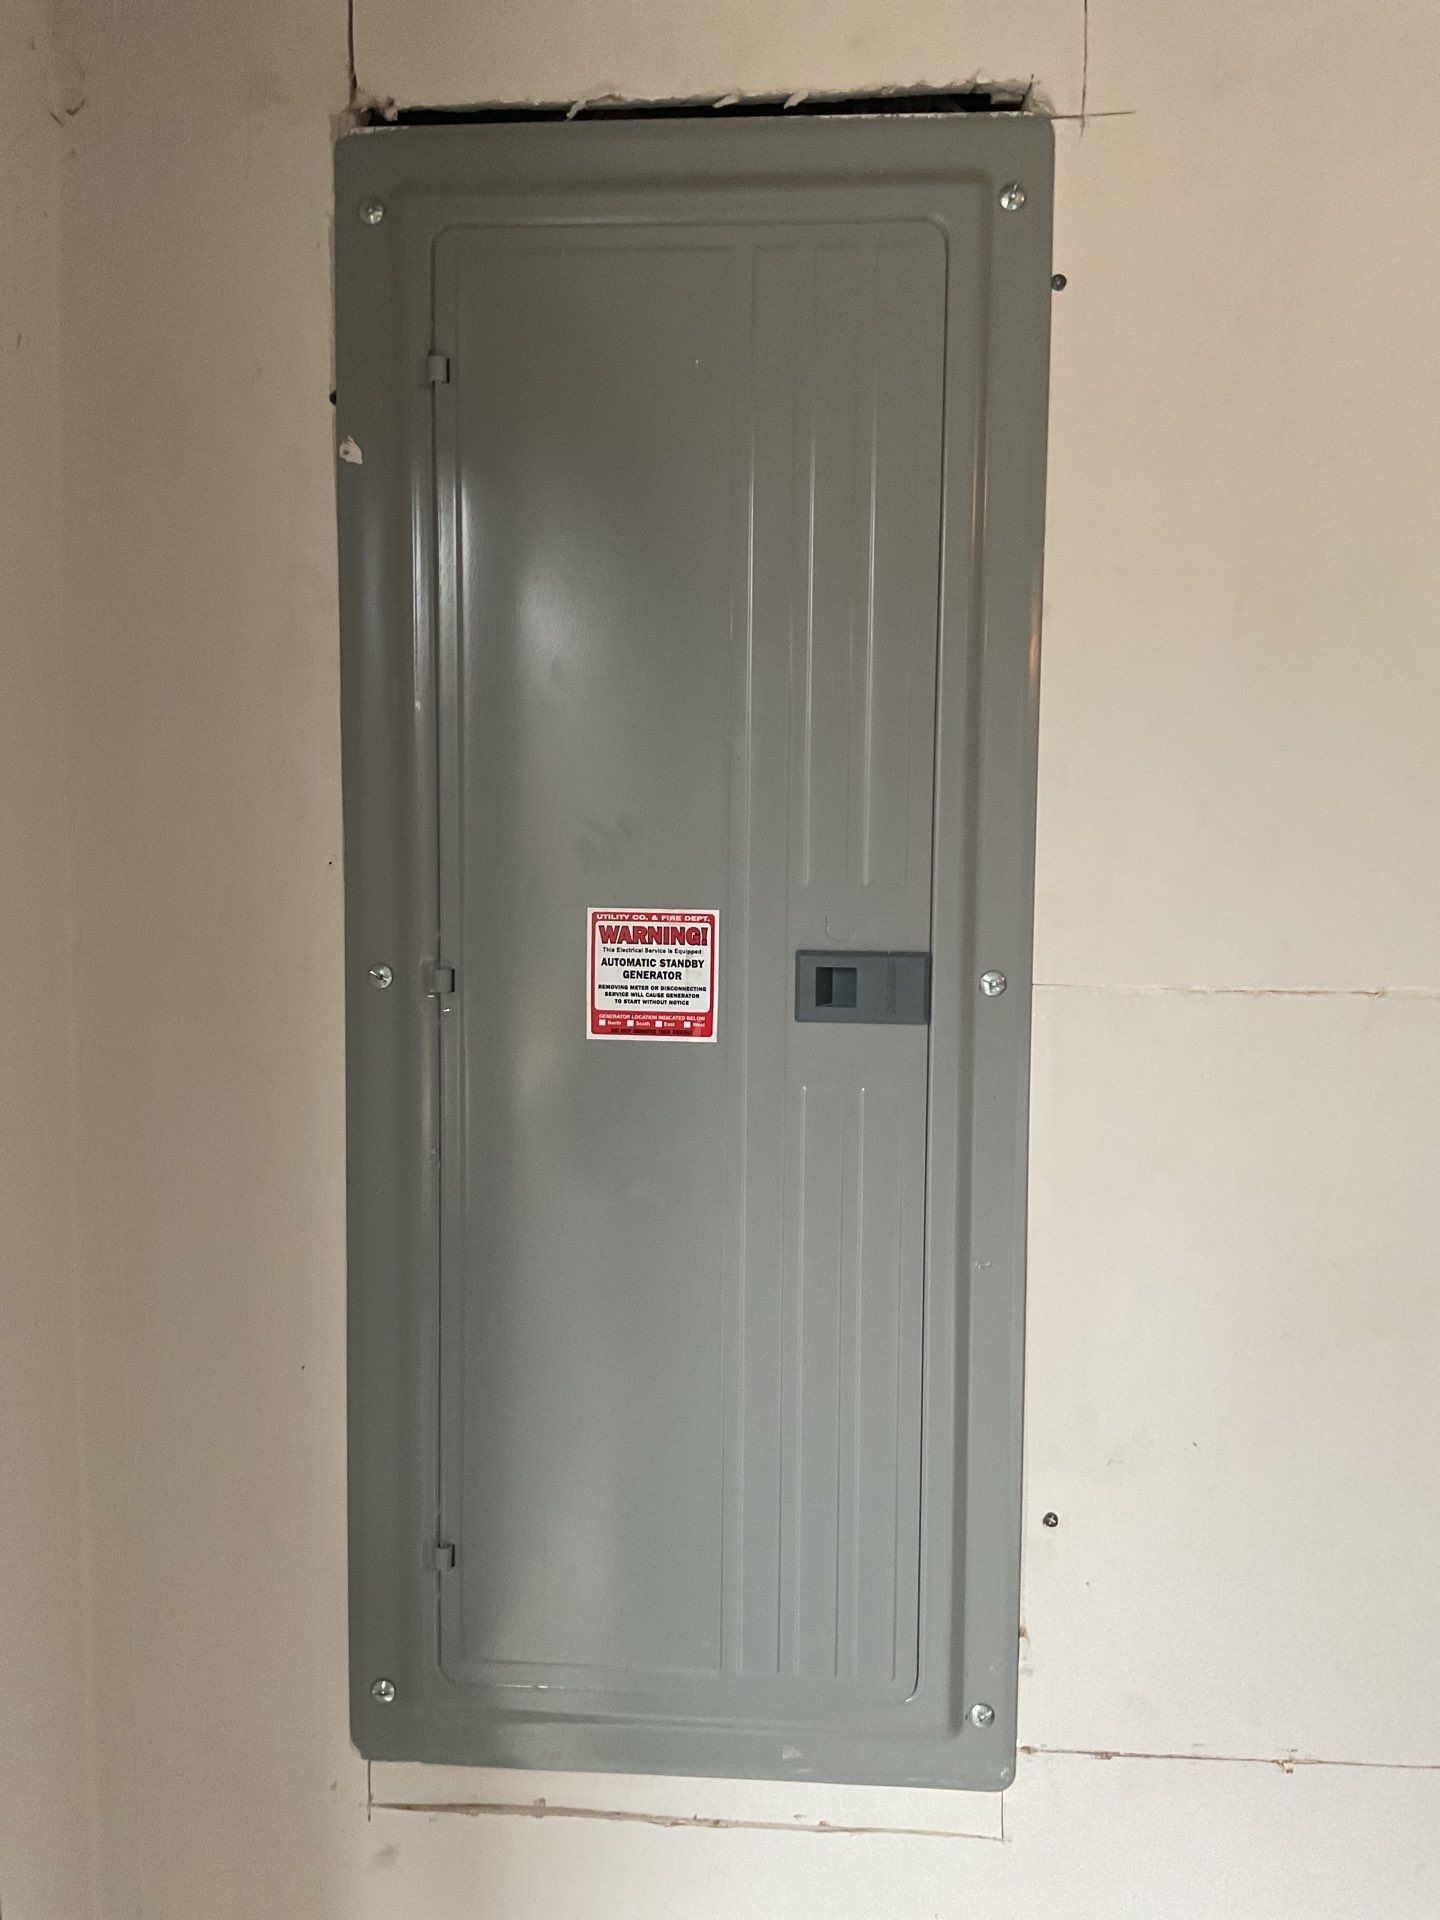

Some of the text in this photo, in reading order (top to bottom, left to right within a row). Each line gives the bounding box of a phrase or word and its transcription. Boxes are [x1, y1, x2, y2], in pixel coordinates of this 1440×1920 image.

[599, 925, 708, 946] WARNING!
[660, 960, 704, 968] STANDBY
[623, 970, 682, 980] GENERATOR
